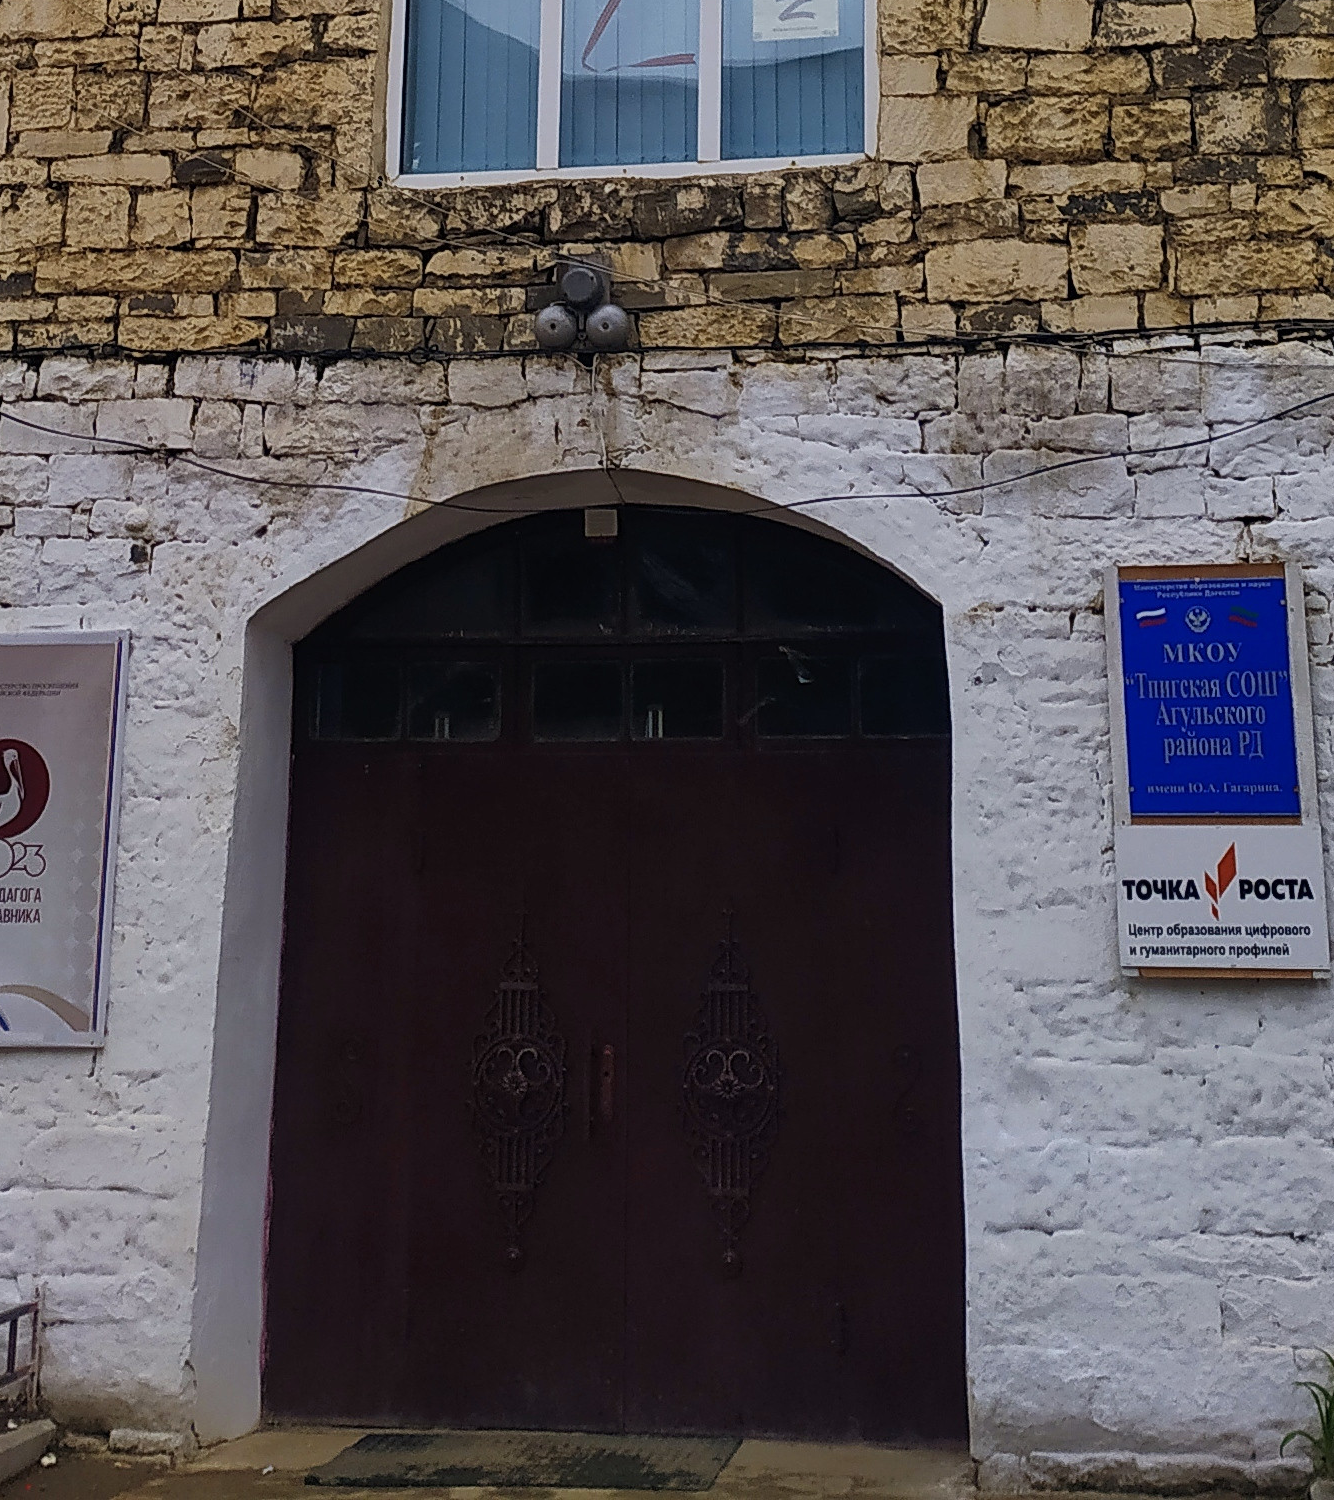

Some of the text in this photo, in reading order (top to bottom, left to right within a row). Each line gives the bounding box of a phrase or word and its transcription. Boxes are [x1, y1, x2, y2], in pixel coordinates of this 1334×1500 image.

[1163, 642, 1242, 664] МКОУ
[1156, 701, 1266, 732] Агульского
[1164, 730, 1264, 763] района РД
[1147, 784, 1185, 794] имени
[1122, 878, 1314, 900] ТОЧКА РОСТА
[1128, 923, 1311, 939] Центр образования цифрового
[1129, 943, 1290, 961] и гуманитарного профилей
